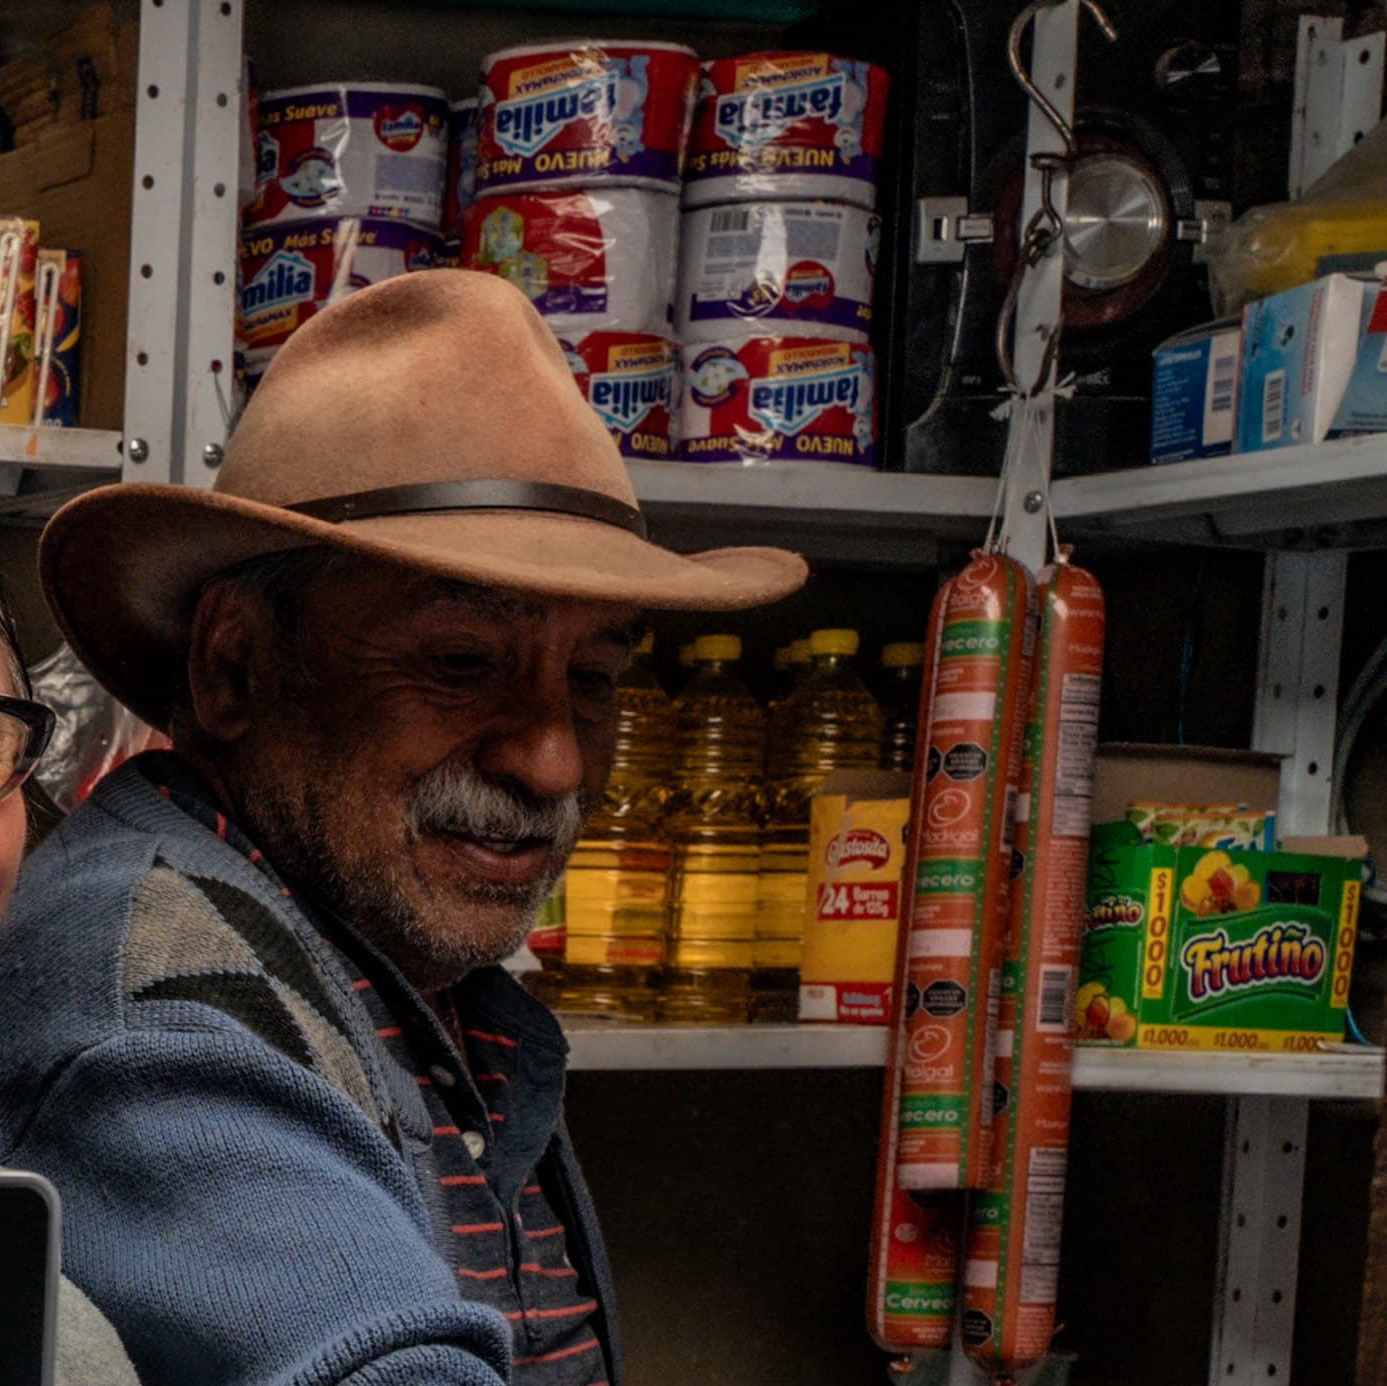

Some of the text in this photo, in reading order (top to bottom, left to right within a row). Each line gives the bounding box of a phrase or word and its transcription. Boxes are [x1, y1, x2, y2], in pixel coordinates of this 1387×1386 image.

[753, 376, 861, 422] familia
[797, 434, 854, 455] NUEVO
[822, 886, 849, 915] 24
[1182, 921, 1325, 1001] Frutiño
